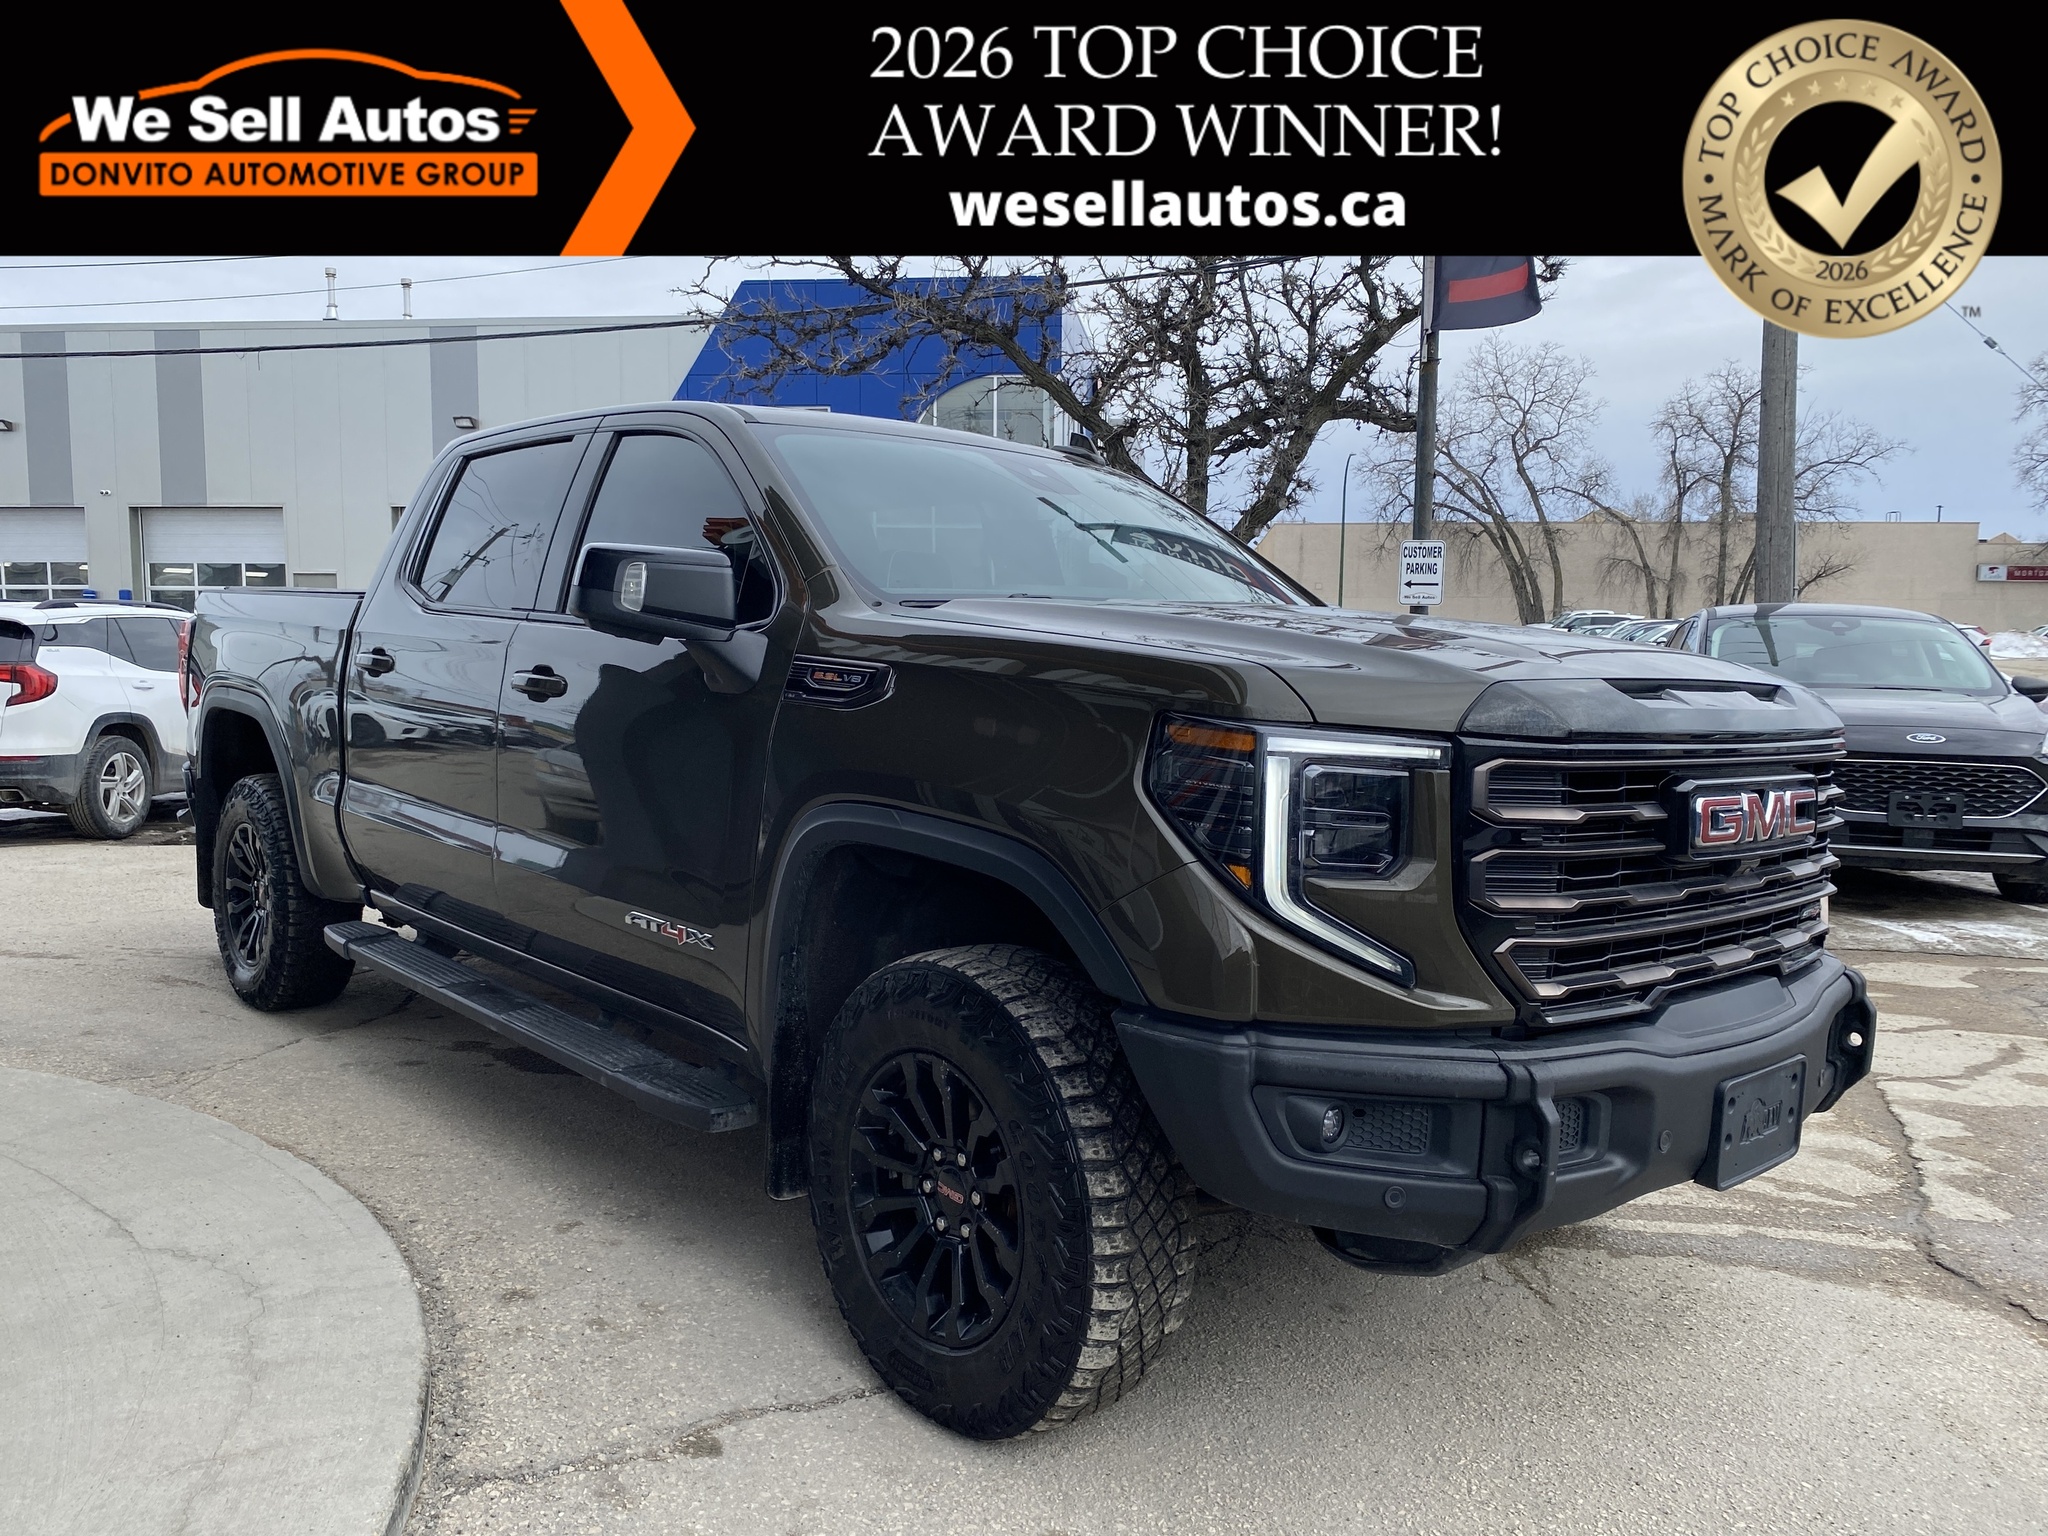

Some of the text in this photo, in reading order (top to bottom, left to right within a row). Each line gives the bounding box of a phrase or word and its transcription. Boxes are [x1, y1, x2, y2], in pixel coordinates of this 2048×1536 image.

[1403, 546, 1442, 559] CUSTOMER
[1405, 562, 1438, 575] PARKING
[843, 674, 862, 683] V8
[1695, 787, 1816, 847] GMC
[625, 911, 715, 950] AT4X
[937, 1180, 965, 1205] GMC
